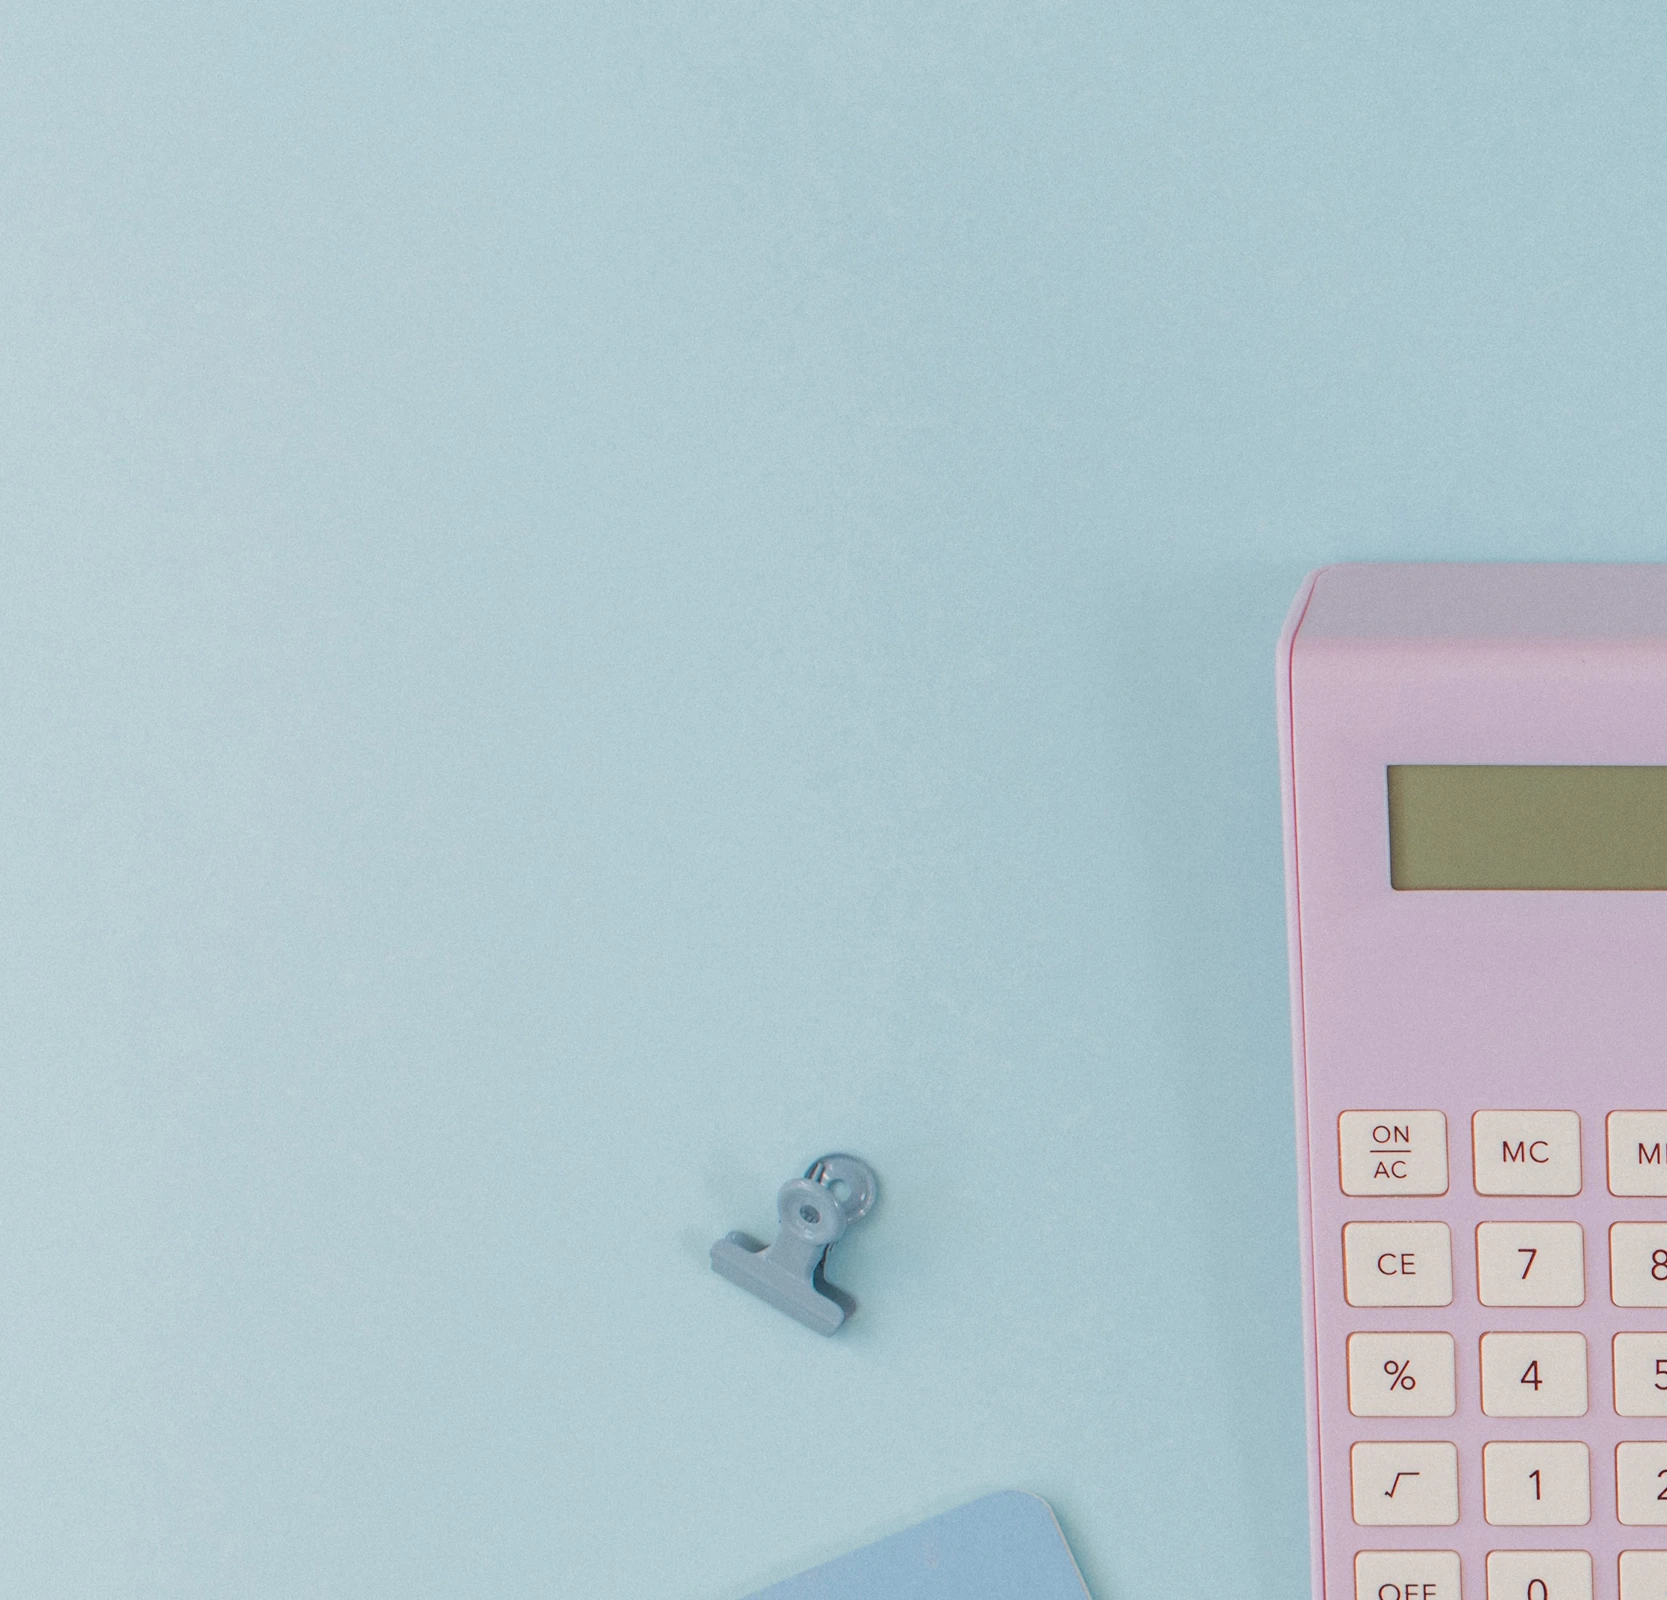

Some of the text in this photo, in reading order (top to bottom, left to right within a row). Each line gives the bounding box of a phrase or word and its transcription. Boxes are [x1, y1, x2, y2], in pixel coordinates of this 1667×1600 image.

[1372, 1125, 1410, 1144] ON
[1501, 1140, 1550, 1164] MC
[1373, 1160, 1408, 1180] AC
[1377, 1252, 1416, 1276] CE
[1517, 1248, 1538, 1280] 7
[1383, 1359, 1417, 1391] %
[1520, 1359, 1543, 1391] 4
[1528, 1469, 1541, 1501] 1
